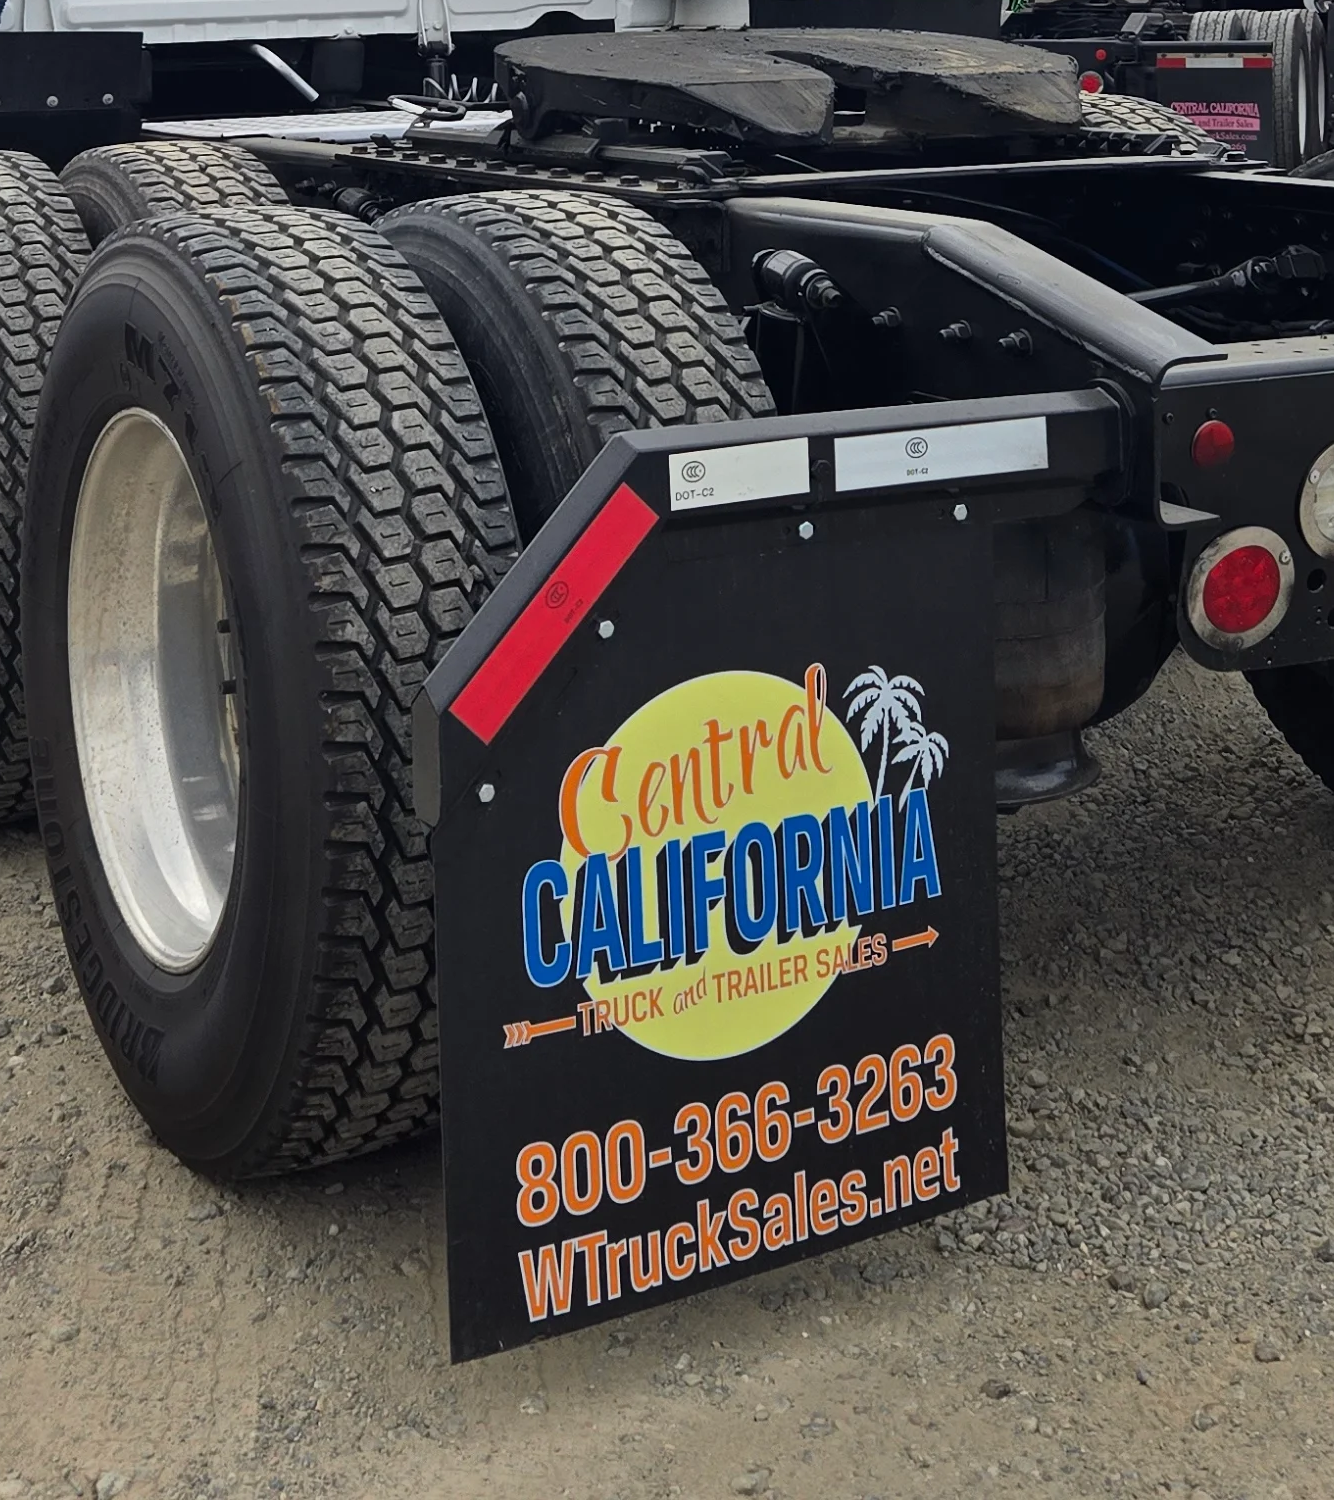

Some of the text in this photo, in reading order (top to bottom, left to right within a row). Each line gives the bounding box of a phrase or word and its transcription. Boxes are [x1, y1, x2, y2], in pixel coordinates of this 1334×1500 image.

[1210, 102, 1260, 117] CALIFORNIA
[1213, 119, 1235, 128] Trailer
[1236, 119, 1254, 128] Sales
[675, 487, 715, 502] DOT-C2
[559, 662, 833, 861] Central
[522, 787, 942, 988] CALIFORNIA
[577, 933, 888, 1037] TRUCK and TRAILER SALES
[515, 1033, 958, 1228] 800-366-3263
[517, 1127, 961, 1323] WTruckSales.net
